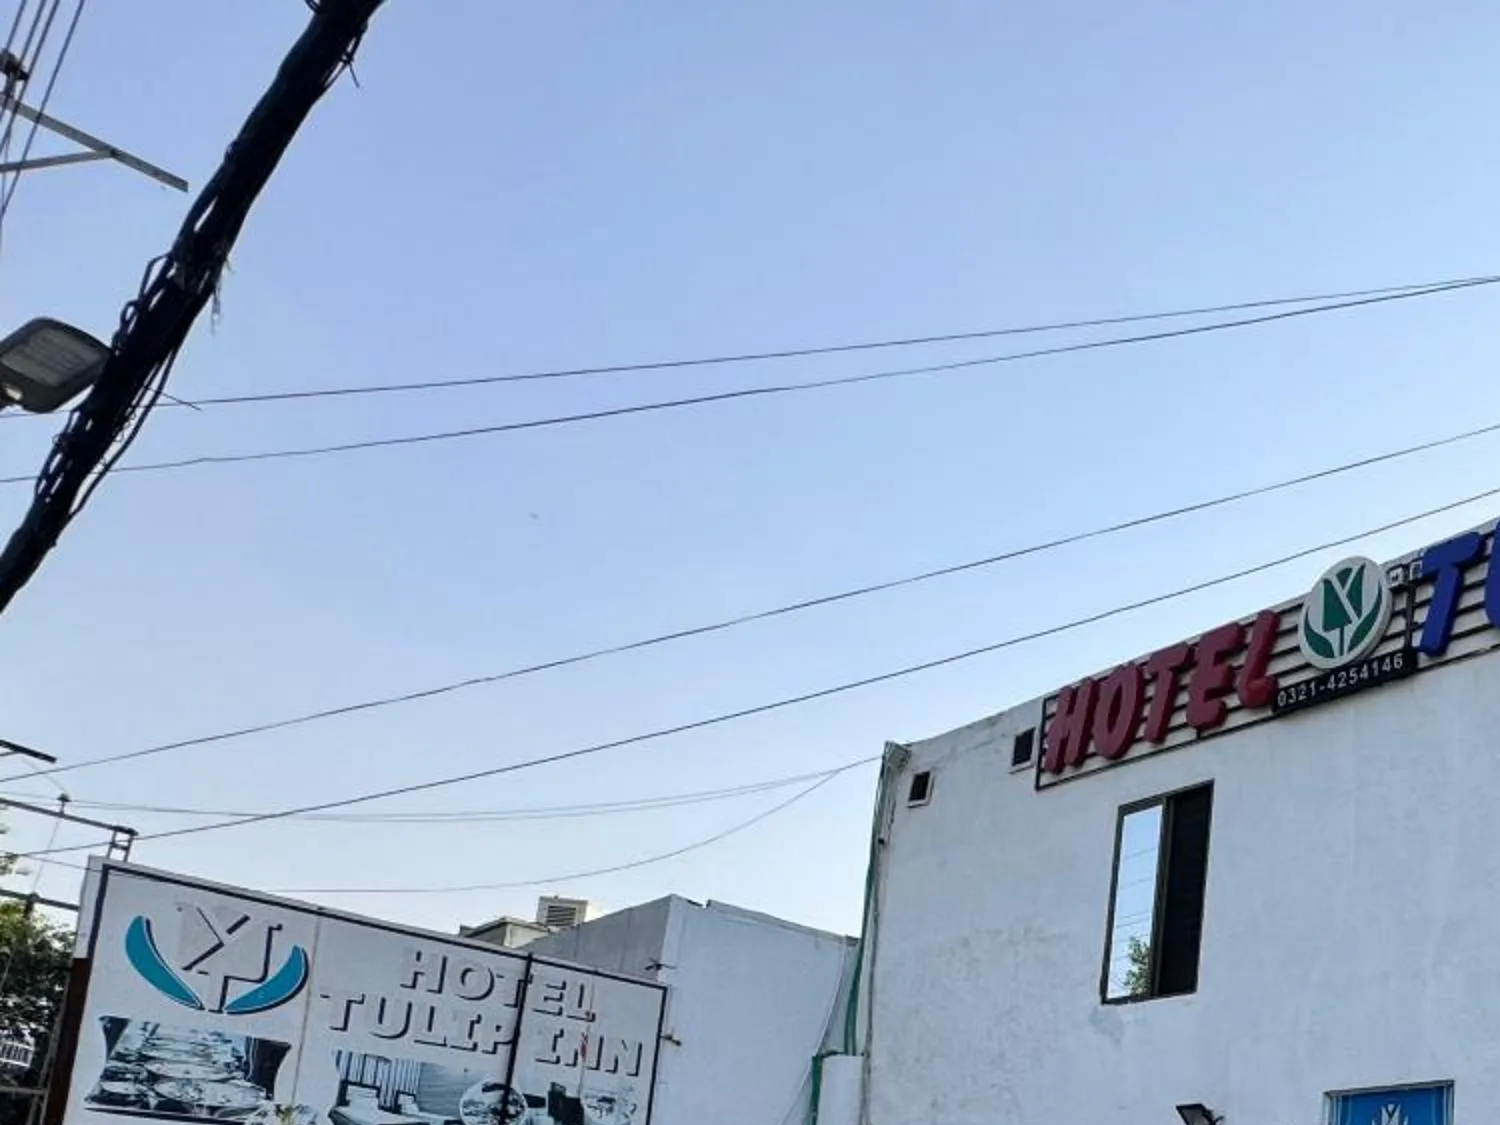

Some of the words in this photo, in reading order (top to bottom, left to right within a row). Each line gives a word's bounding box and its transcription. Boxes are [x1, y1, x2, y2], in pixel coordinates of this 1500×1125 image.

[1043, 609, 1281, 775] HOTEL
[1276, 652, 1404, 707] 0321-4254146
[397, 945, 597, 1023] HOTEL
[316, 989, 518, 1056] TULIP
[534, 1024, 644, 1077] INN
